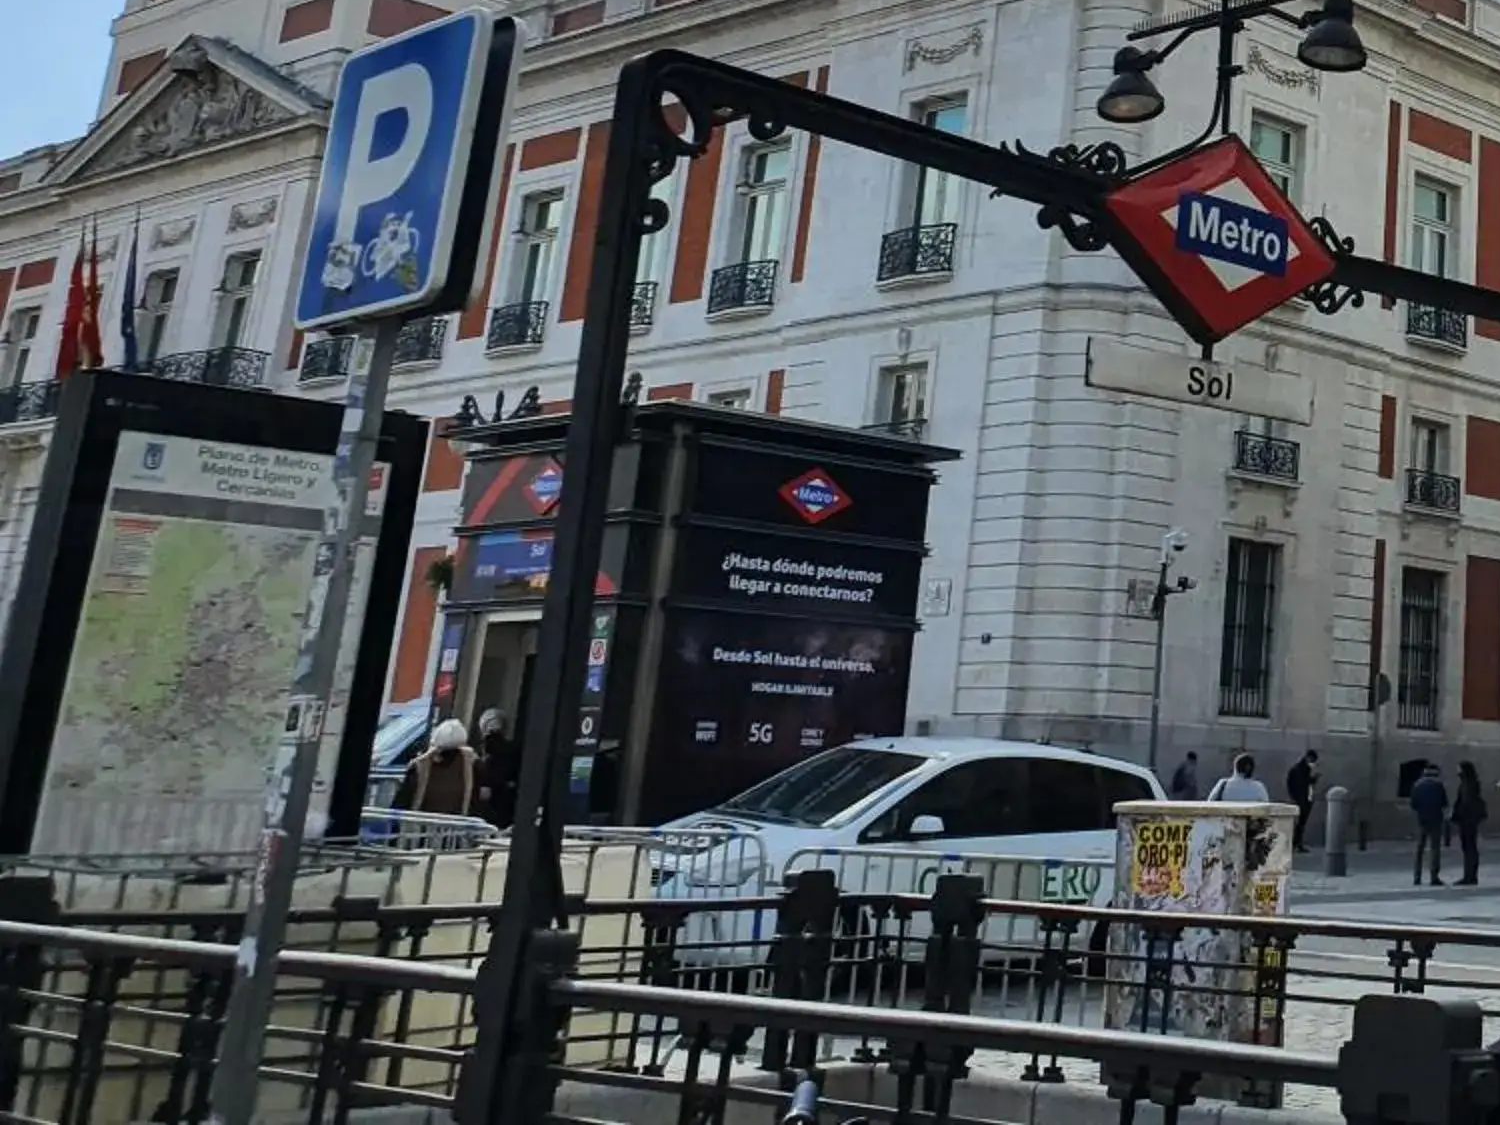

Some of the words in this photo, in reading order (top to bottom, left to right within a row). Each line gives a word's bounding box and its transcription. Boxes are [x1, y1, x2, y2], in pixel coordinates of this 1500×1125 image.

[333, 62, 433, 253] P
[1188, 200, 1281, 263] Metro
[1187, 365, 1233, 401] Sol
[198, 445, 244, 462] Plano
[247, 453, 270, 466] de
[201, 460, 249, 478] Metro
[252, 466, 304, 486] Ligero
[306, 476, 318, 489] y
[798, 487, 834, 505] Metro
[721, 551, 771, 571] ¿Hasta
[772, 557, 815, 577] dónde
[816, 563, 883, 584] podremos
[728, 574, 770, 595] llegar
[772, 581, 782, 594] a
[783, 581, 874, 603] conectarnos?
[712, 646, 753, 663] Desde
[753, 650, 773, 666] Sol
[773, 652, 807, 668] hasta
[748, 722, 774, 744] 5G
